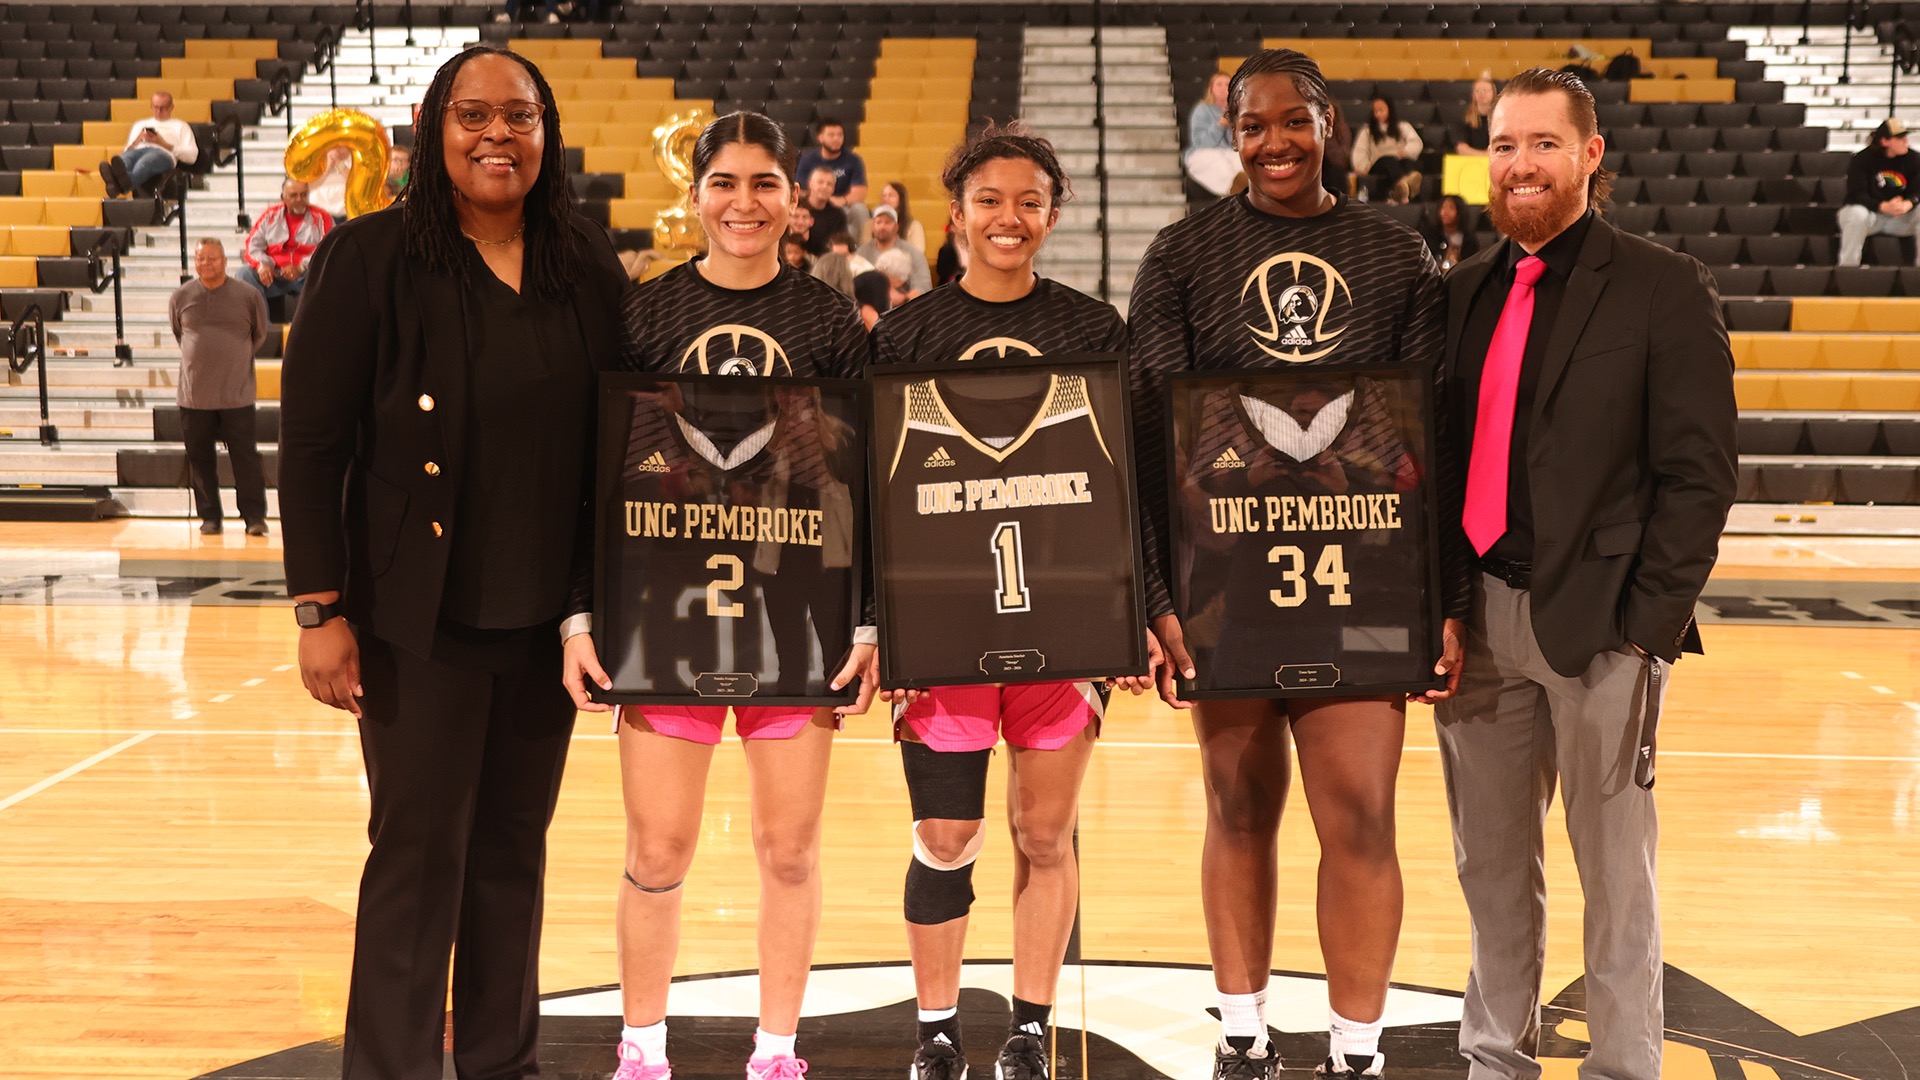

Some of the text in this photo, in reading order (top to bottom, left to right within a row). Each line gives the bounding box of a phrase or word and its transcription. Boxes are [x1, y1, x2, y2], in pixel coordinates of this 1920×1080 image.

[1281, 337, 1313, 346] adidas
[638, 463, 671, 473] adidas
[924, 458, 956, 468] adidas
[1213, 460, 1246, 469] adidas
[917, 472, 1092, 515] UNC PEMBROKE
[1209, 493, 1402, 534] UNC PEMBROKE
[624, 500, 823, 546] UNC PEMBROKE
[706, 553, 744, 618] 2
[990, 521, 1031, 614] 1
[1267, 544, 1352, 608] 34
